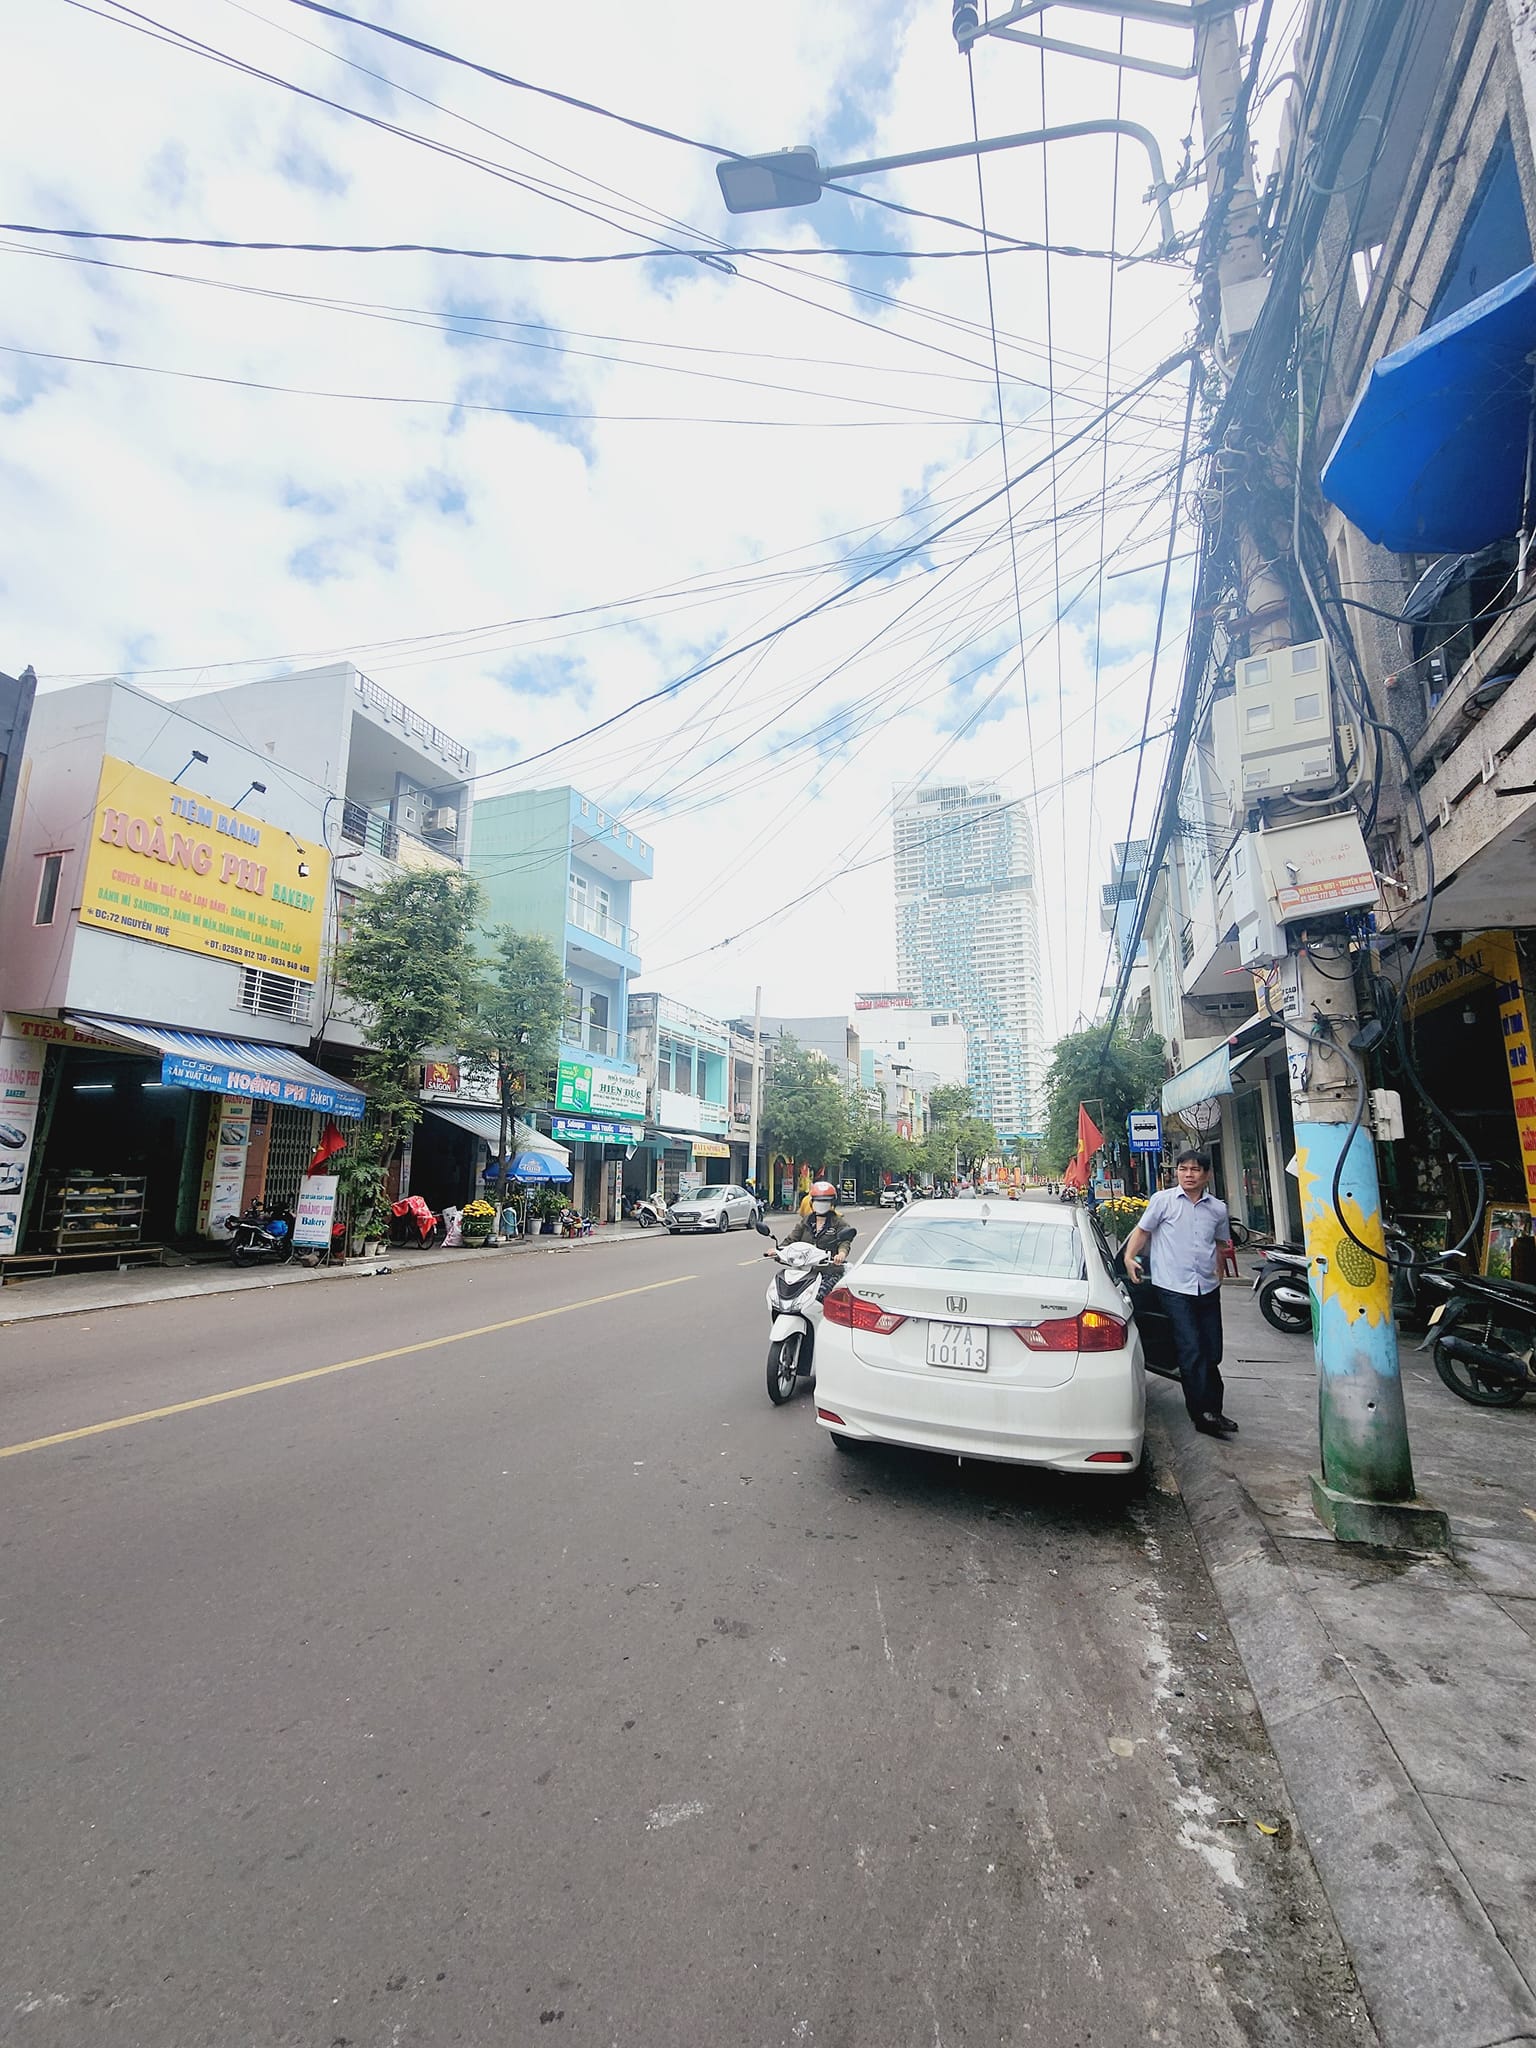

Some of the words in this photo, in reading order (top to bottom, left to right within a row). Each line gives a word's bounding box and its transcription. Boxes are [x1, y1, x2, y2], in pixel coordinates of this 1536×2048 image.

[170, 795, 213, 828] TIỆM
[216, 815, 260, 847] BÁNH
[100, 808, 212, 875] HOÀNG
[219, 852, 267, 896] PHI
[272, 883, 315, 913] BAKERY
[155, 924, 170, 938] HUỆ
[21, 1021, 67, 1041] TIỆM
[284, 1082, 307, 1102] PHI
[310, 1088, 333, 1108] Bakery
[428, 1081, 452, 1092] SAIGON
[301, 1216, 327, 1229] Bakery
[858, 1290, 885, 1299] CITY
[941, 1323, 973, 1346] 77A
[930, 1343, 985, 1368] 101.13
